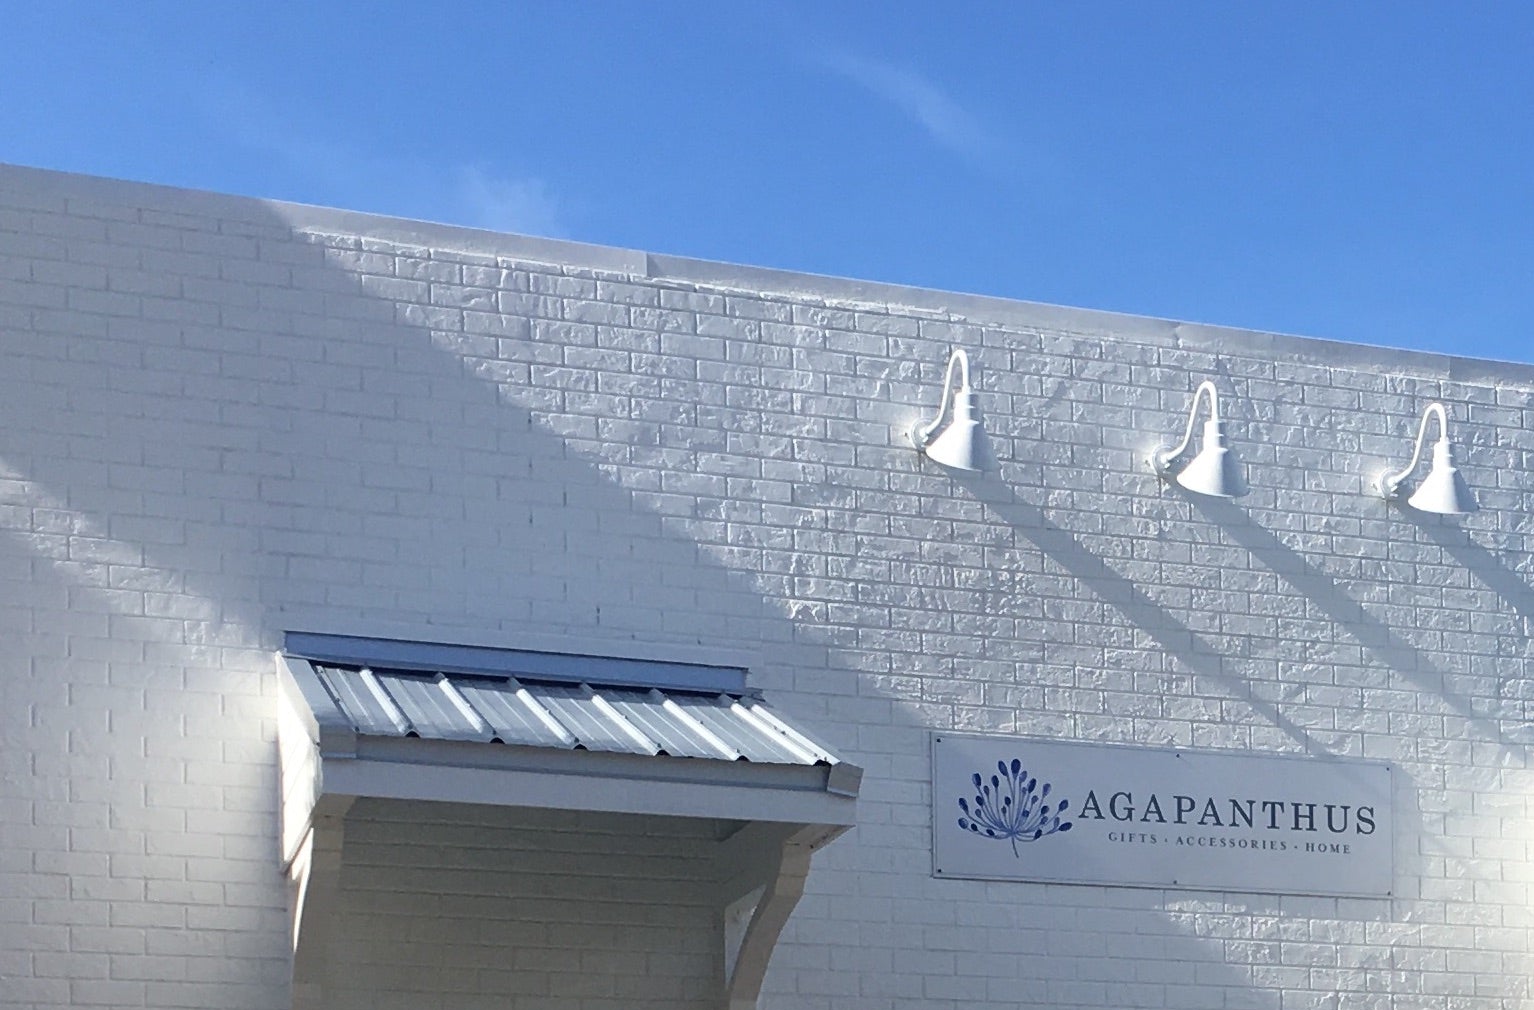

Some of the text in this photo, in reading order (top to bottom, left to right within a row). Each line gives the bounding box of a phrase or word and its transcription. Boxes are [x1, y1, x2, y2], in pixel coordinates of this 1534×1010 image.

[1078, 789, 1376, 835] AGAPANTHUS
[1108, 831, 1352, 855] GIFTS ACCESSORIES HOME
